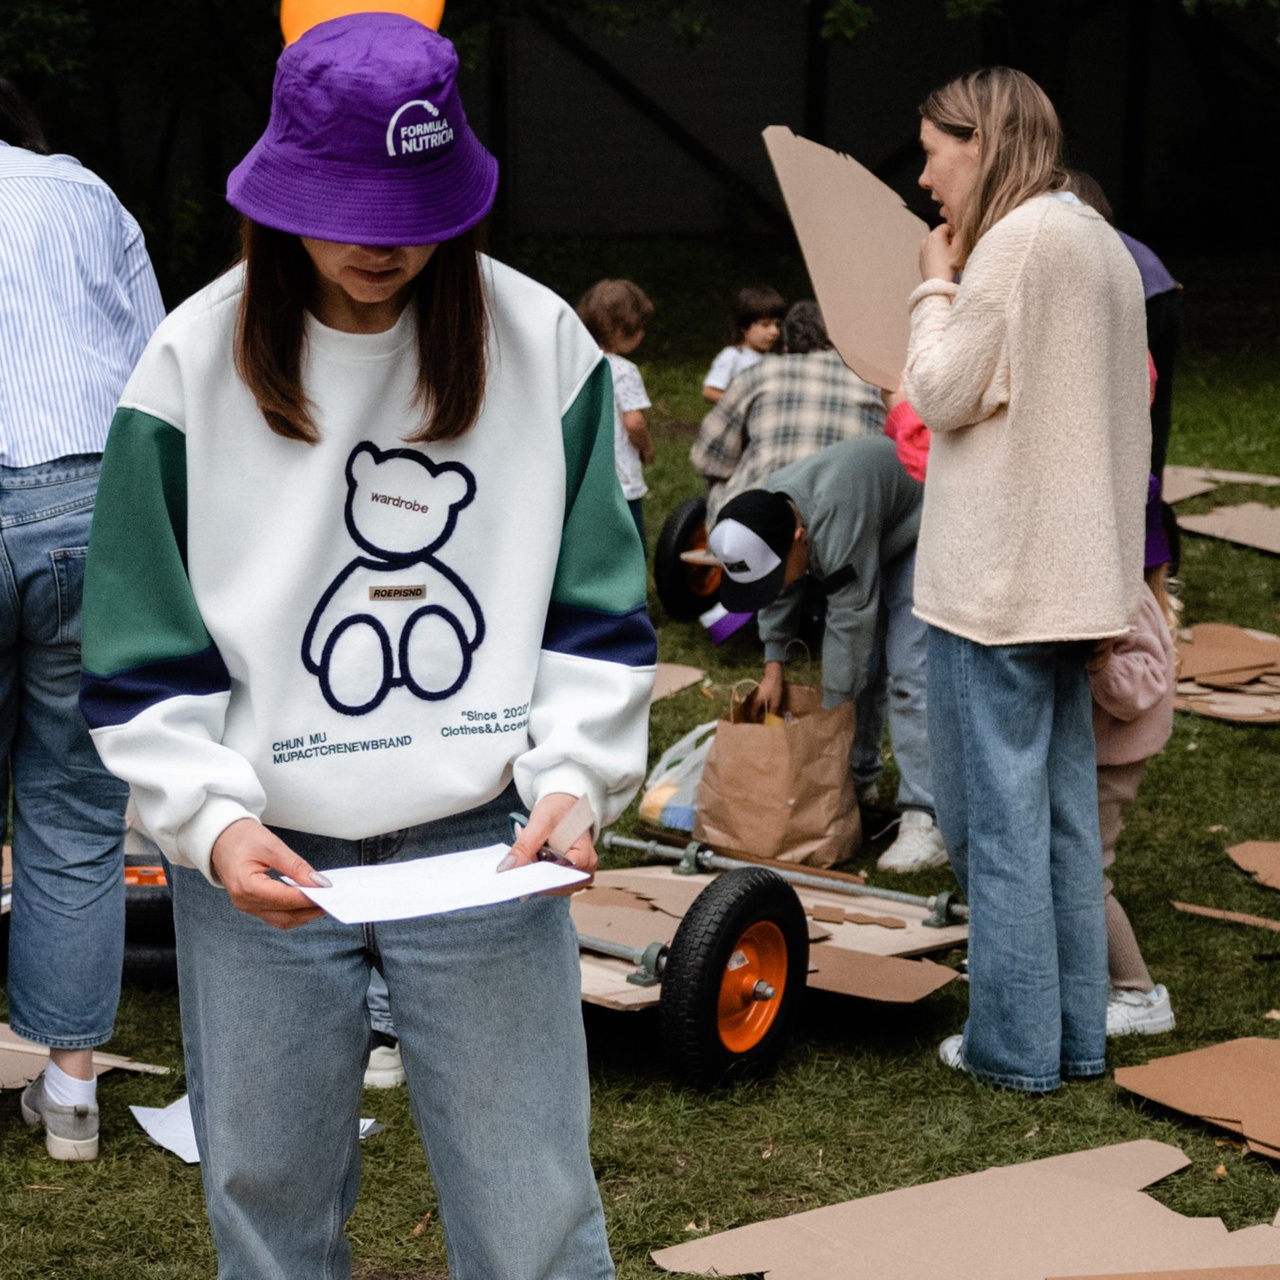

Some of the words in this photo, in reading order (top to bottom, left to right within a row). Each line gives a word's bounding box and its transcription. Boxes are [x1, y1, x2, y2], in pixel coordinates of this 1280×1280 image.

[401, 118, 448, 139] FORMULA
[402, 128, 454, 154] NUTRICIA
[371, 492, 429, 514] wardrobe
[272, 737, 305, 752] CHUN
[309, 732, 327, 744] MU
[273, 735, 412, 764] MUPACTCRENEWBRAND
